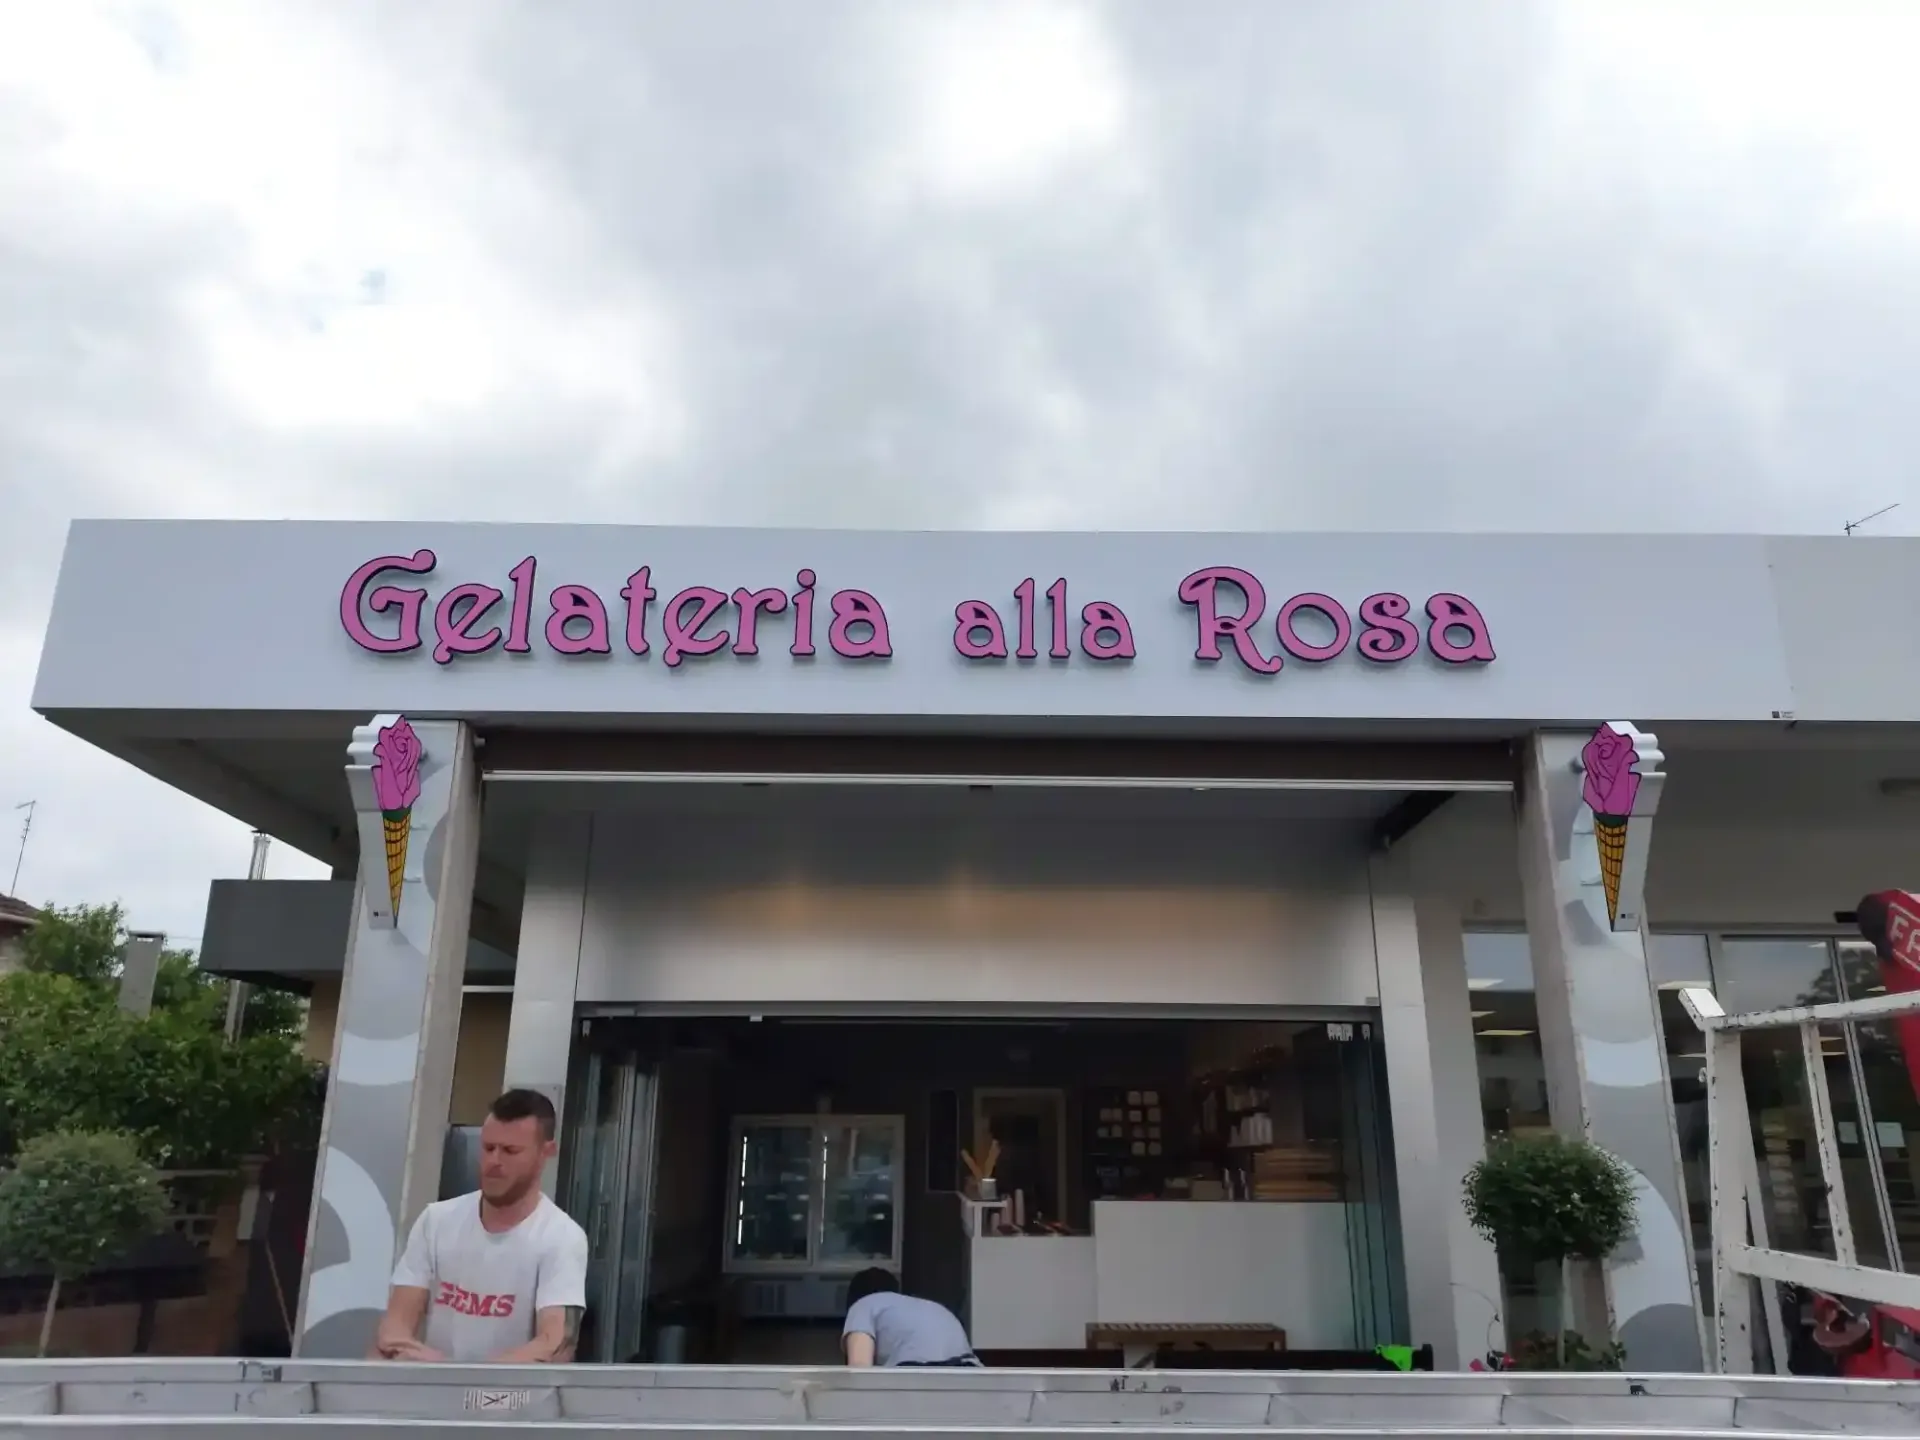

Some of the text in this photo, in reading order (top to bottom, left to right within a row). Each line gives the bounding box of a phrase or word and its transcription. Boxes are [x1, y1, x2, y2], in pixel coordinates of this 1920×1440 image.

[340, 549, 1497, 675] Gelateria alla Rosa
